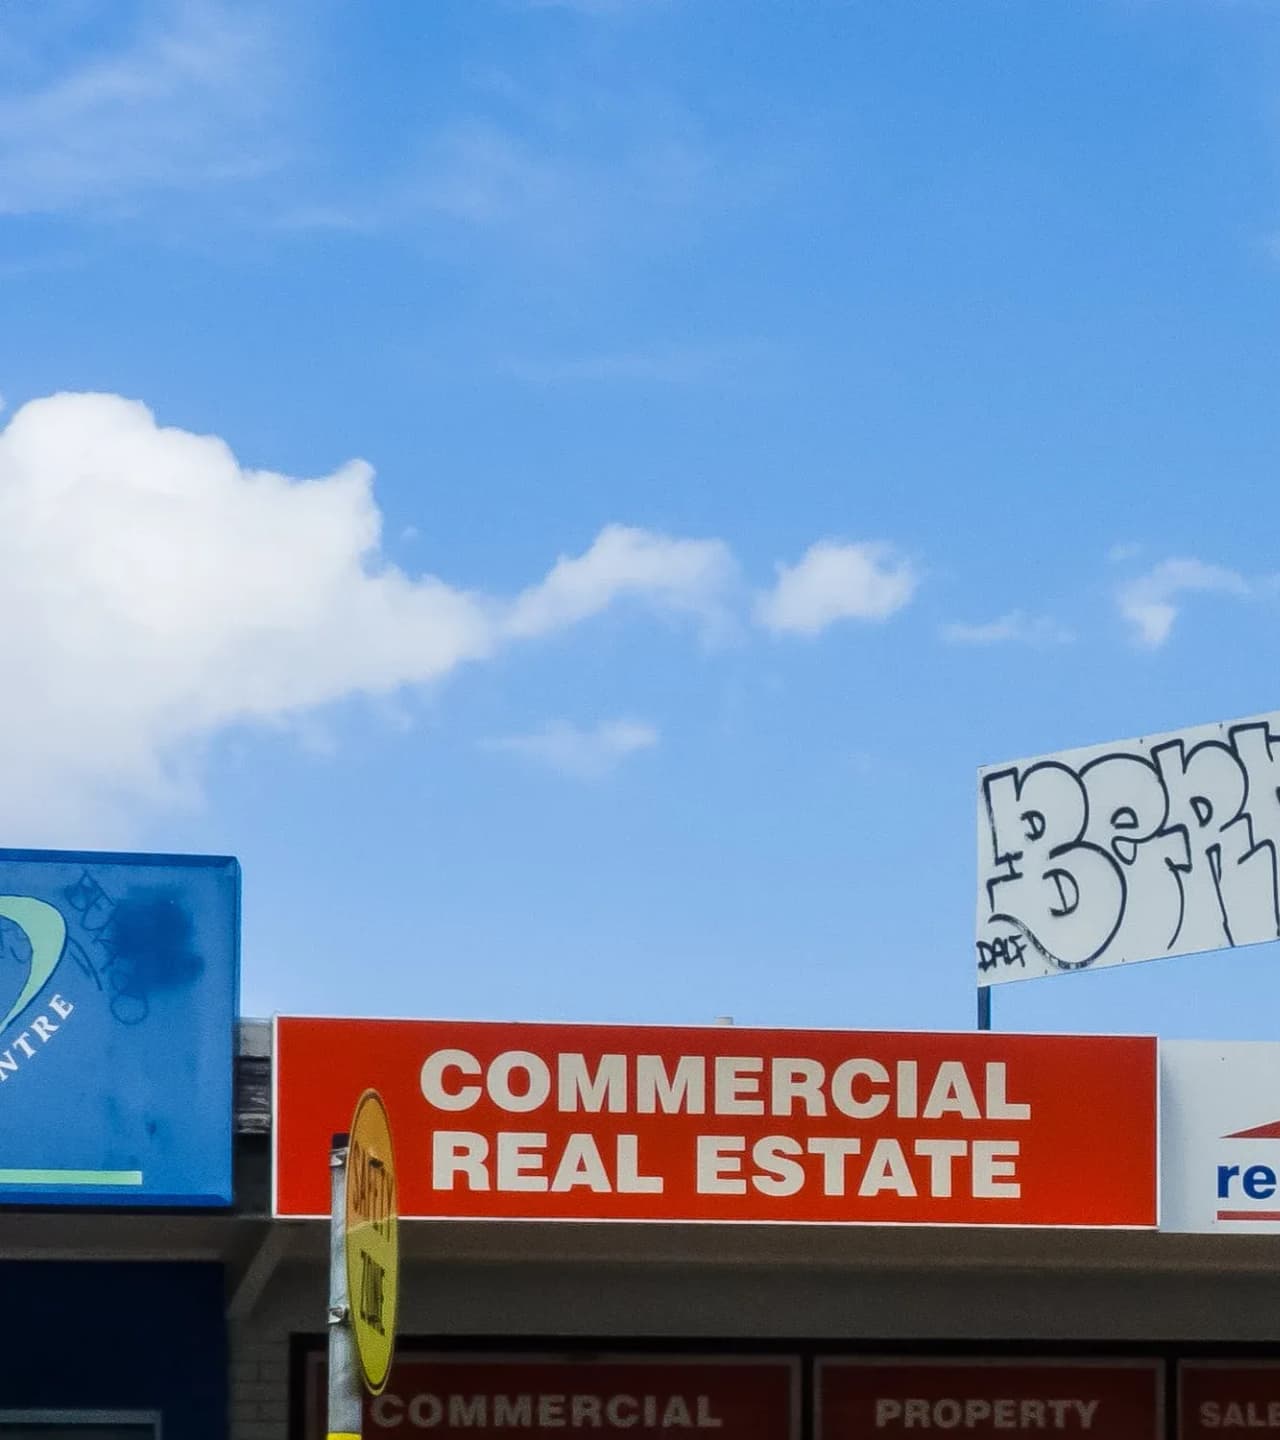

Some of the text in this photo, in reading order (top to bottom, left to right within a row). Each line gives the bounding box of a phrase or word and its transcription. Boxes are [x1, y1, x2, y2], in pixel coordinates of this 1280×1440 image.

[420, 1049, 1031, 1120] COMMERCIAL
[432, 1131, 1021, 1198] REAL ESTATE
[370, 1394, 723, 1428] COMMERCIAL
[875, 1399, 1099, 1429] PROPERTY
